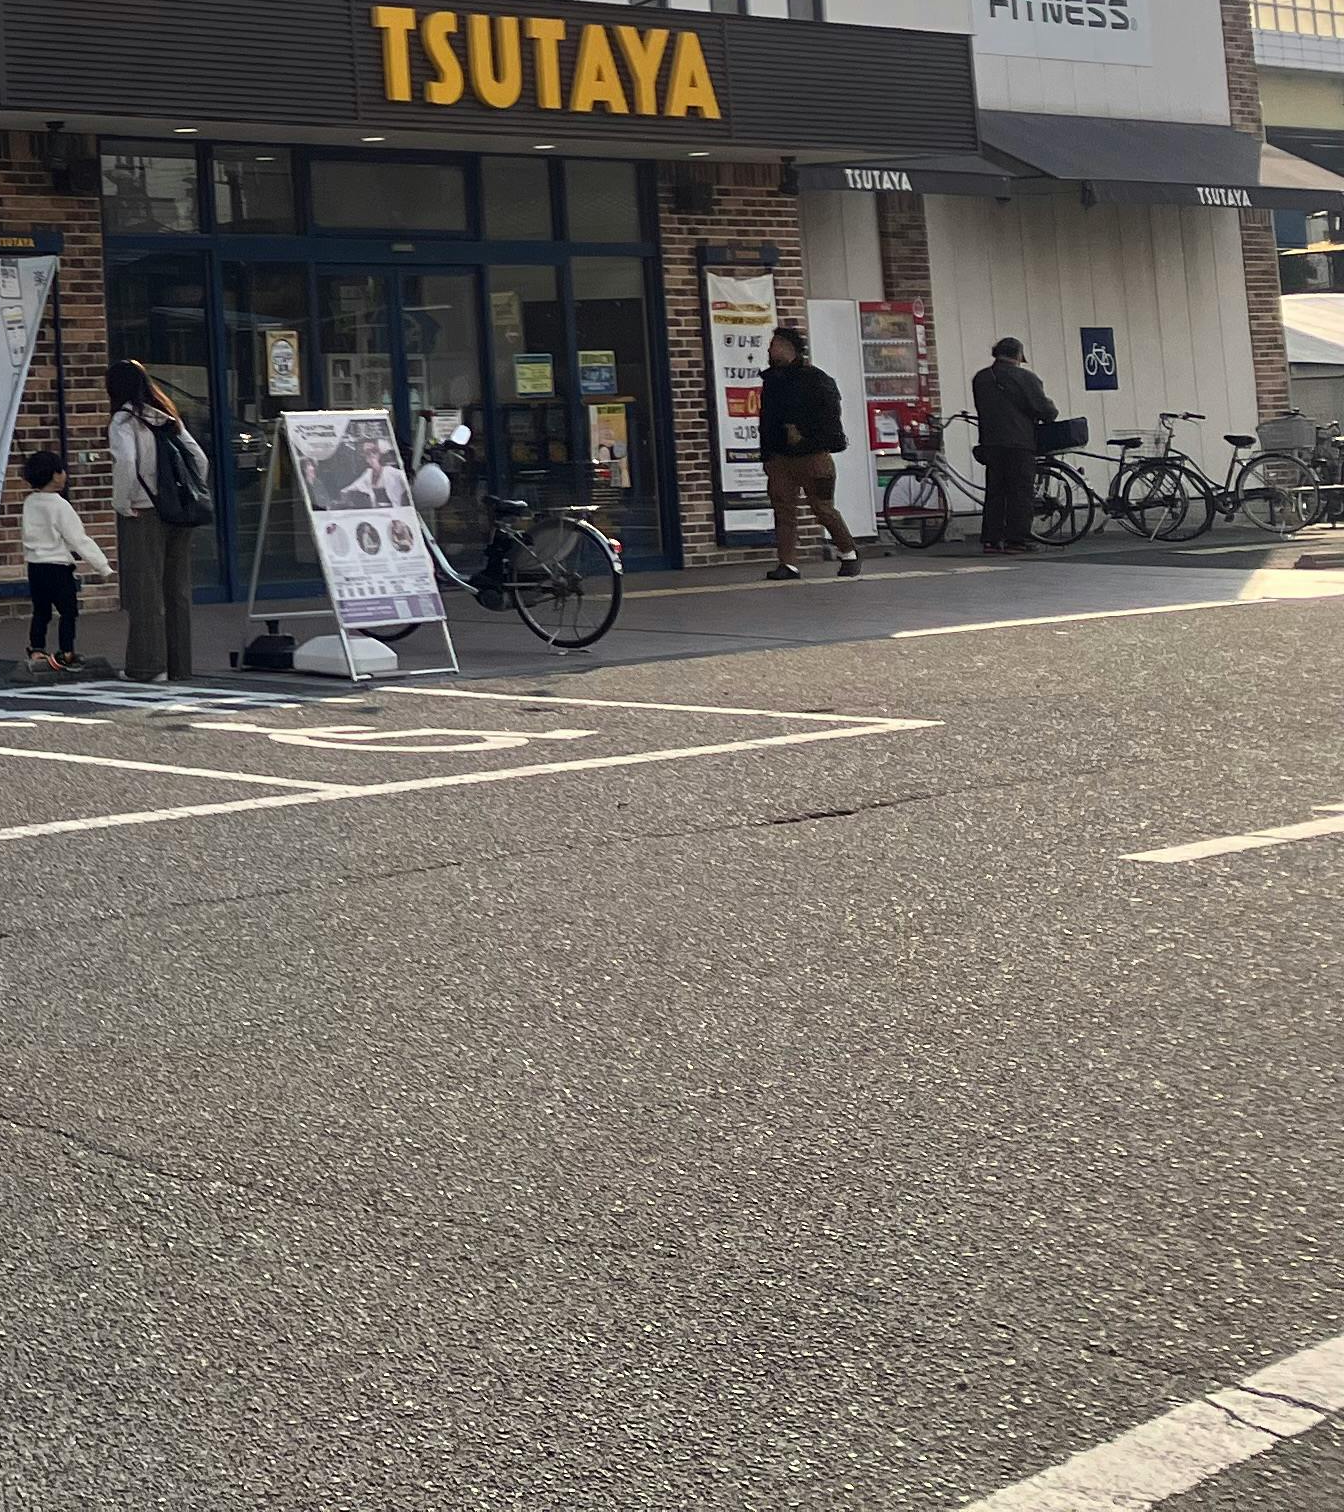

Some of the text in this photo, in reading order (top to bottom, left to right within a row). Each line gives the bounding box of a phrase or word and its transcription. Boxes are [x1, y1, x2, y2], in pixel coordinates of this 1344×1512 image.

[370, 4, 723, 119] TSUTAYA
[844, 168, 912, 191] TSUTAYA
[1197, 186, 1252, 207] TSUTAYA
